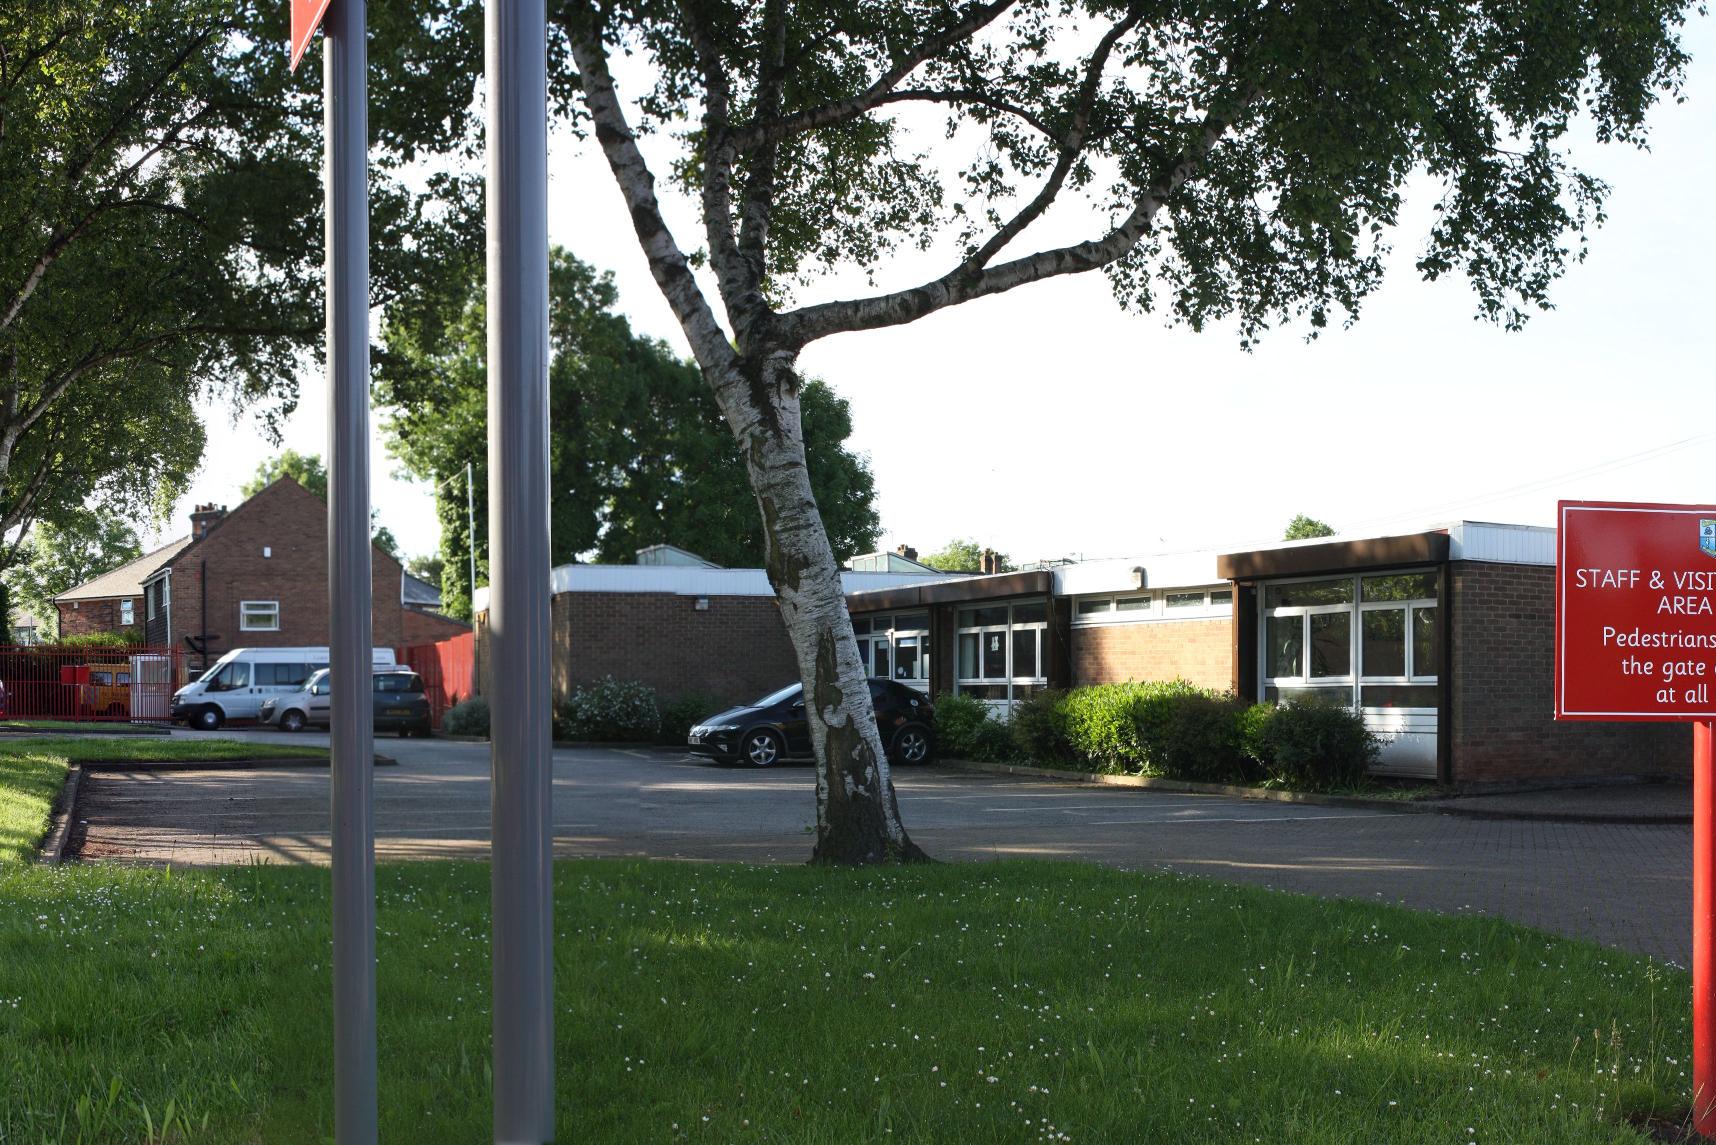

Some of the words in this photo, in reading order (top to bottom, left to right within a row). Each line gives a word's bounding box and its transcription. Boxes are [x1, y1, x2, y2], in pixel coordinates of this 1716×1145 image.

[1575, 569, 1641, 589] STAFF
[1649, 571, 1665, 590] &
[1657, 596, 1713, 615] AREA
[1621, 655, 1654, 675] the
[1662, 661, 1706, 683] gate
[1656, 688, 1676, 703] at
[1684, 684, 1709, 704] all
